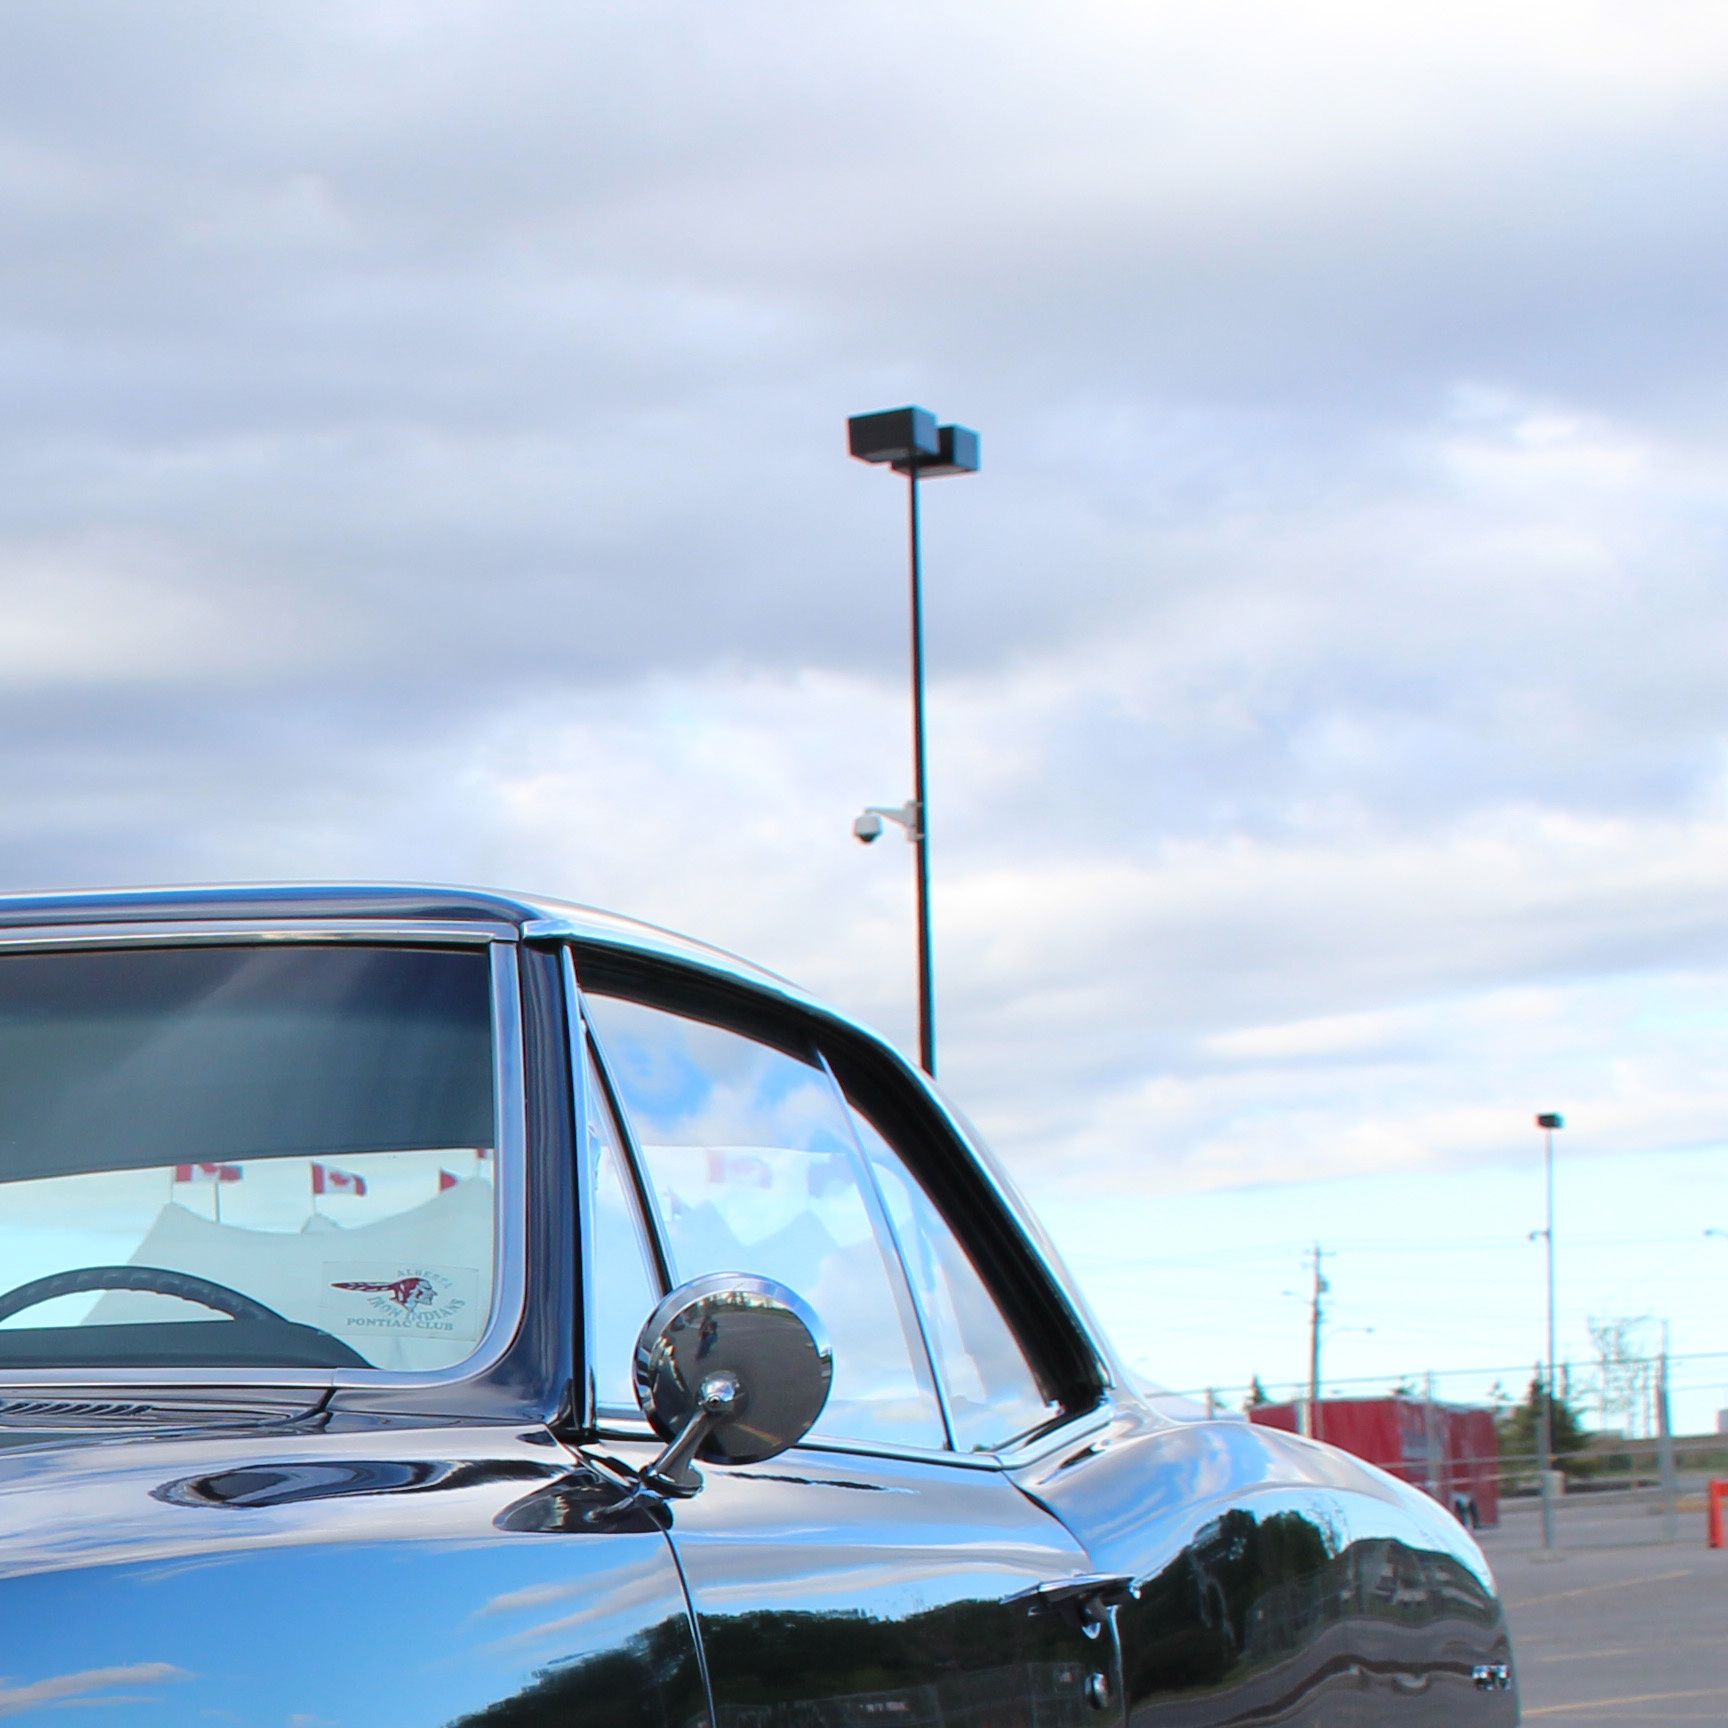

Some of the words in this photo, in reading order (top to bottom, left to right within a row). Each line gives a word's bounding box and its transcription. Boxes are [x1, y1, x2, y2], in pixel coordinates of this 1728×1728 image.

[397, 1268, 454, 1289] ALBERTA
[366, 1296, 404, 1318] IRON
[405, 1298, 466, 1322] INDIANS
[346, 1317, 413, 1329] PONTIAC
[415, 1319, 454, 1331] CLUB
